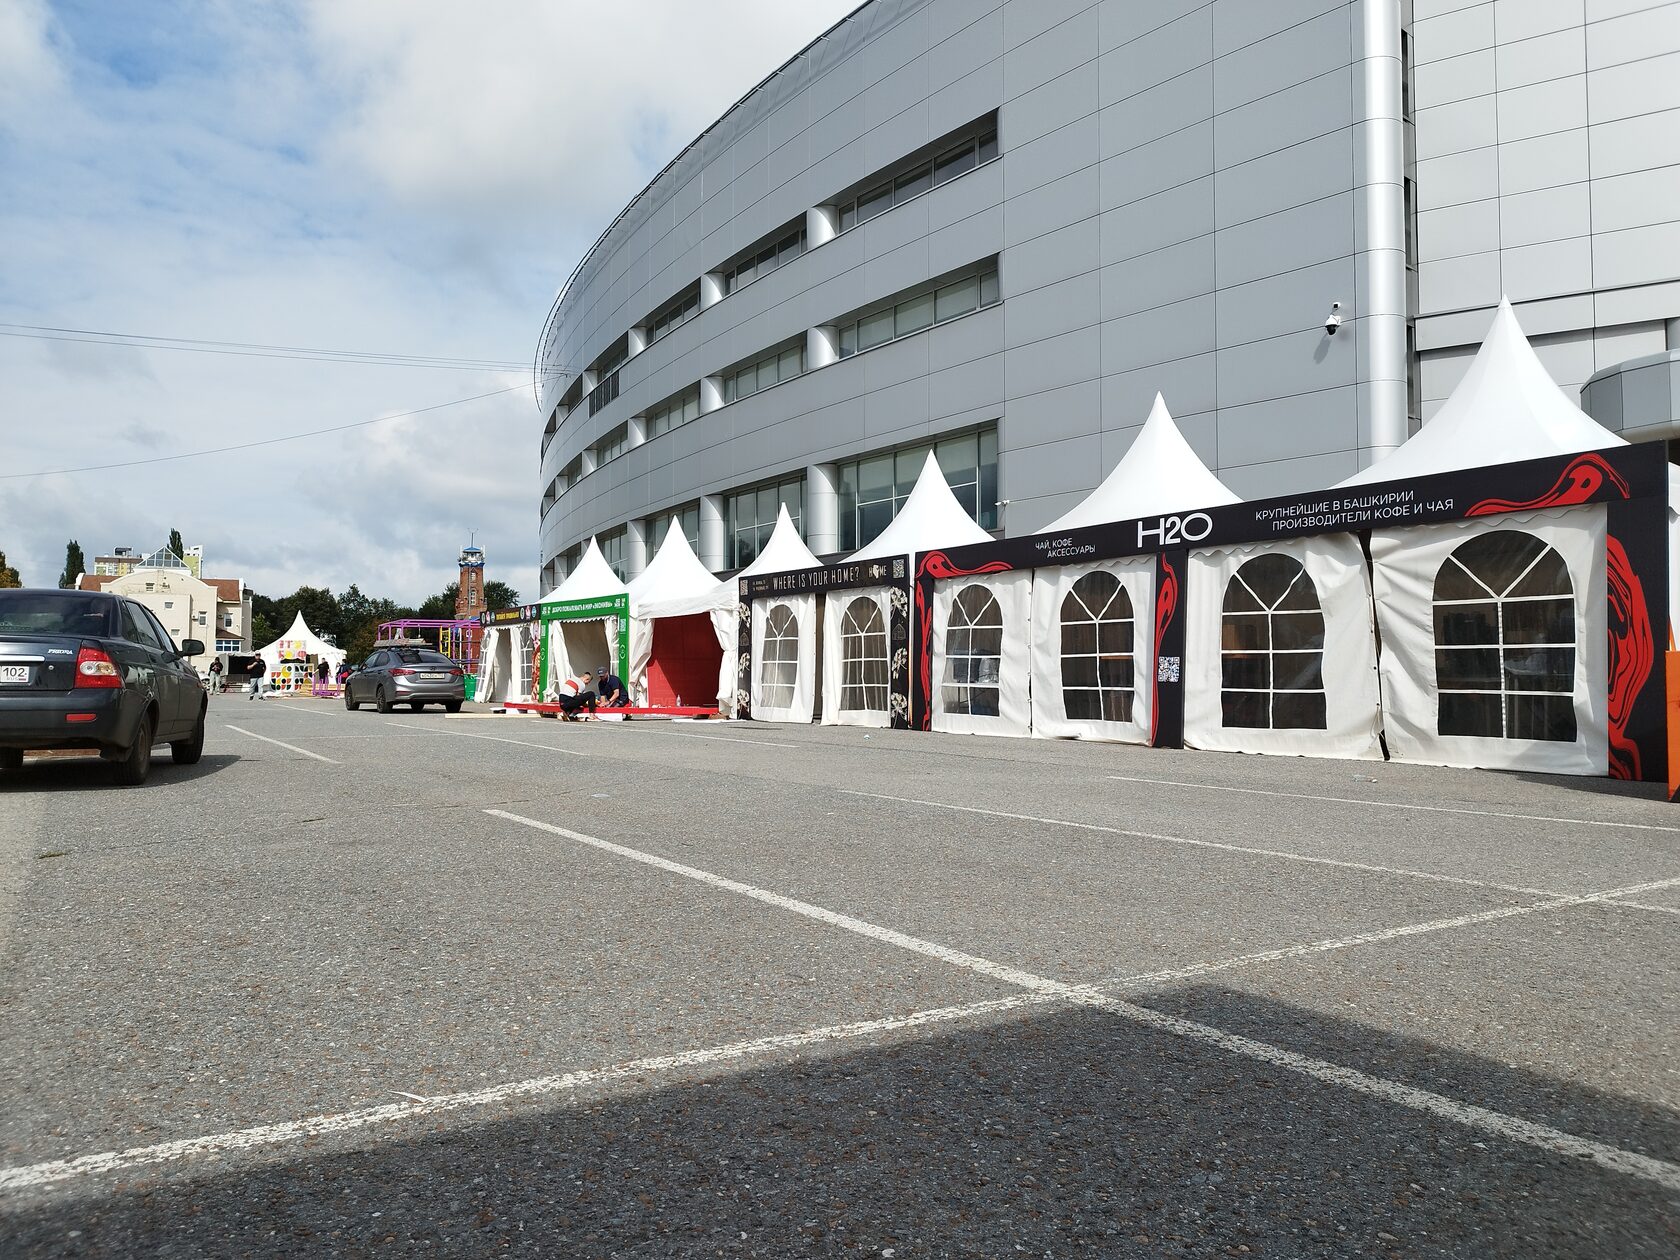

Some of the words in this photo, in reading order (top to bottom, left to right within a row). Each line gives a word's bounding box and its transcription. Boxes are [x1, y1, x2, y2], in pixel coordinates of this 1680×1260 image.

[1255, 500, 1330, 521] КРУПНЕЙШИЕ
[1332, 500, 1340, 511] В
[1343, 490, 1414, 510] БАШКИРИИ
[1272, 510, 1371, 531] ПРОИЗВОДИТЕЛИ
[1374, 504, 1410, 520] КОФЕ
[1413, 503, 1423, 514] И
[1426, 498, 1454, 512] ЧАЯ
[1052, 537, 1073, 547] КОФЕ
[1137, 512, 1213, 548] H2O
[1046, 545, 1096, 559] АКСЕССУАРЫ
[772, 575, 796, 590] WHERE
[798, 575, 806, 588] IS
[808, 571, 829, 586] YOUR
[831, 566, 860, 583] HOME?
[3, 667, 25, 677] 102
